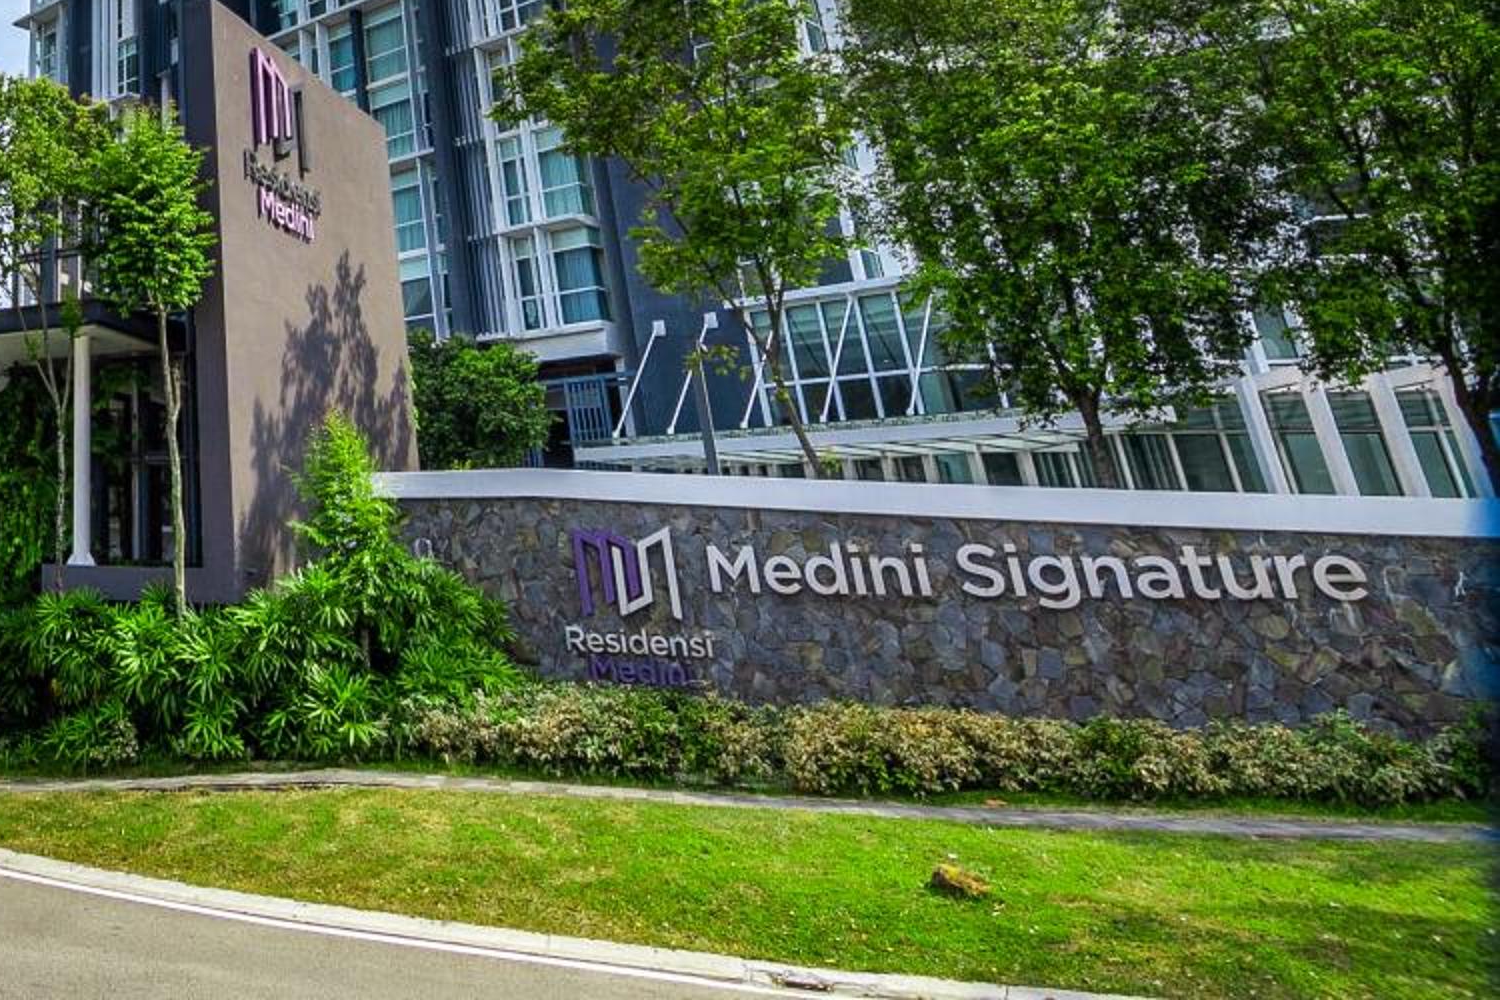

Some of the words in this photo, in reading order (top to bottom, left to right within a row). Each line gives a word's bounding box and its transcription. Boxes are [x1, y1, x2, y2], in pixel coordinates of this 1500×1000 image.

[258, 185, 315, 241] Medini
[706, 541, 932, 597] Medini
[956, 542, 1368, 609] Signature
[565, 625, 714, 659] Residensi
